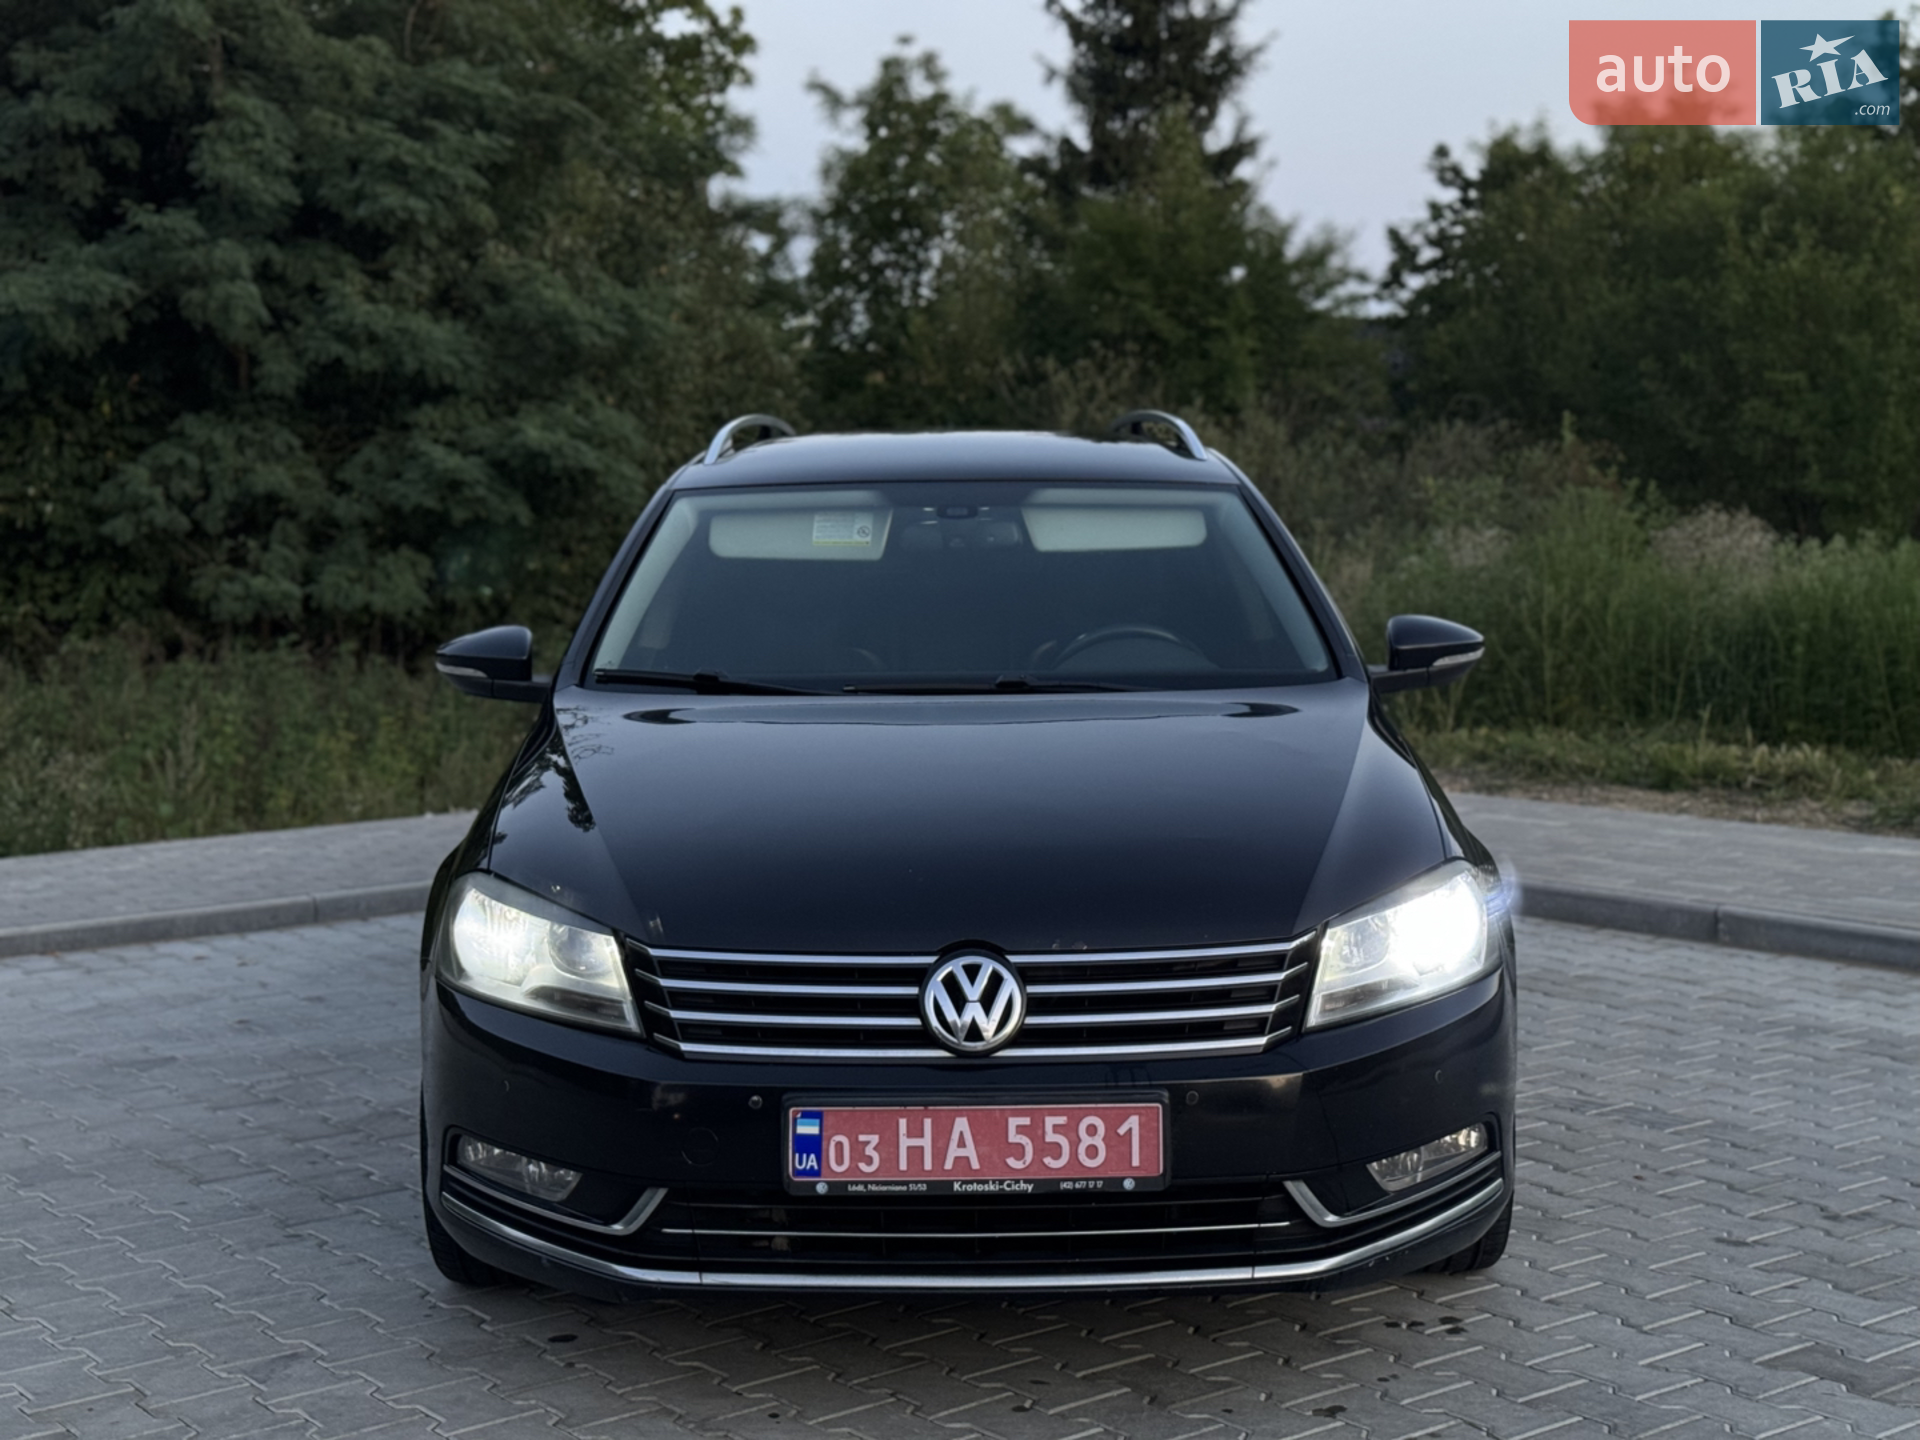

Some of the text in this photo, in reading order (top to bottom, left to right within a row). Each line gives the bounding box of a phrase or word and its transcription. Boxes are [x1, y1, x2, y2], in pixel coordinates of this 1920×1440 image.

[828, 1115, 1140, 1173] 03 HA 5581
[795, 1153, 819, 1170] UA
[953, 1180, 1034, 1193] Krotoski-Cichy
